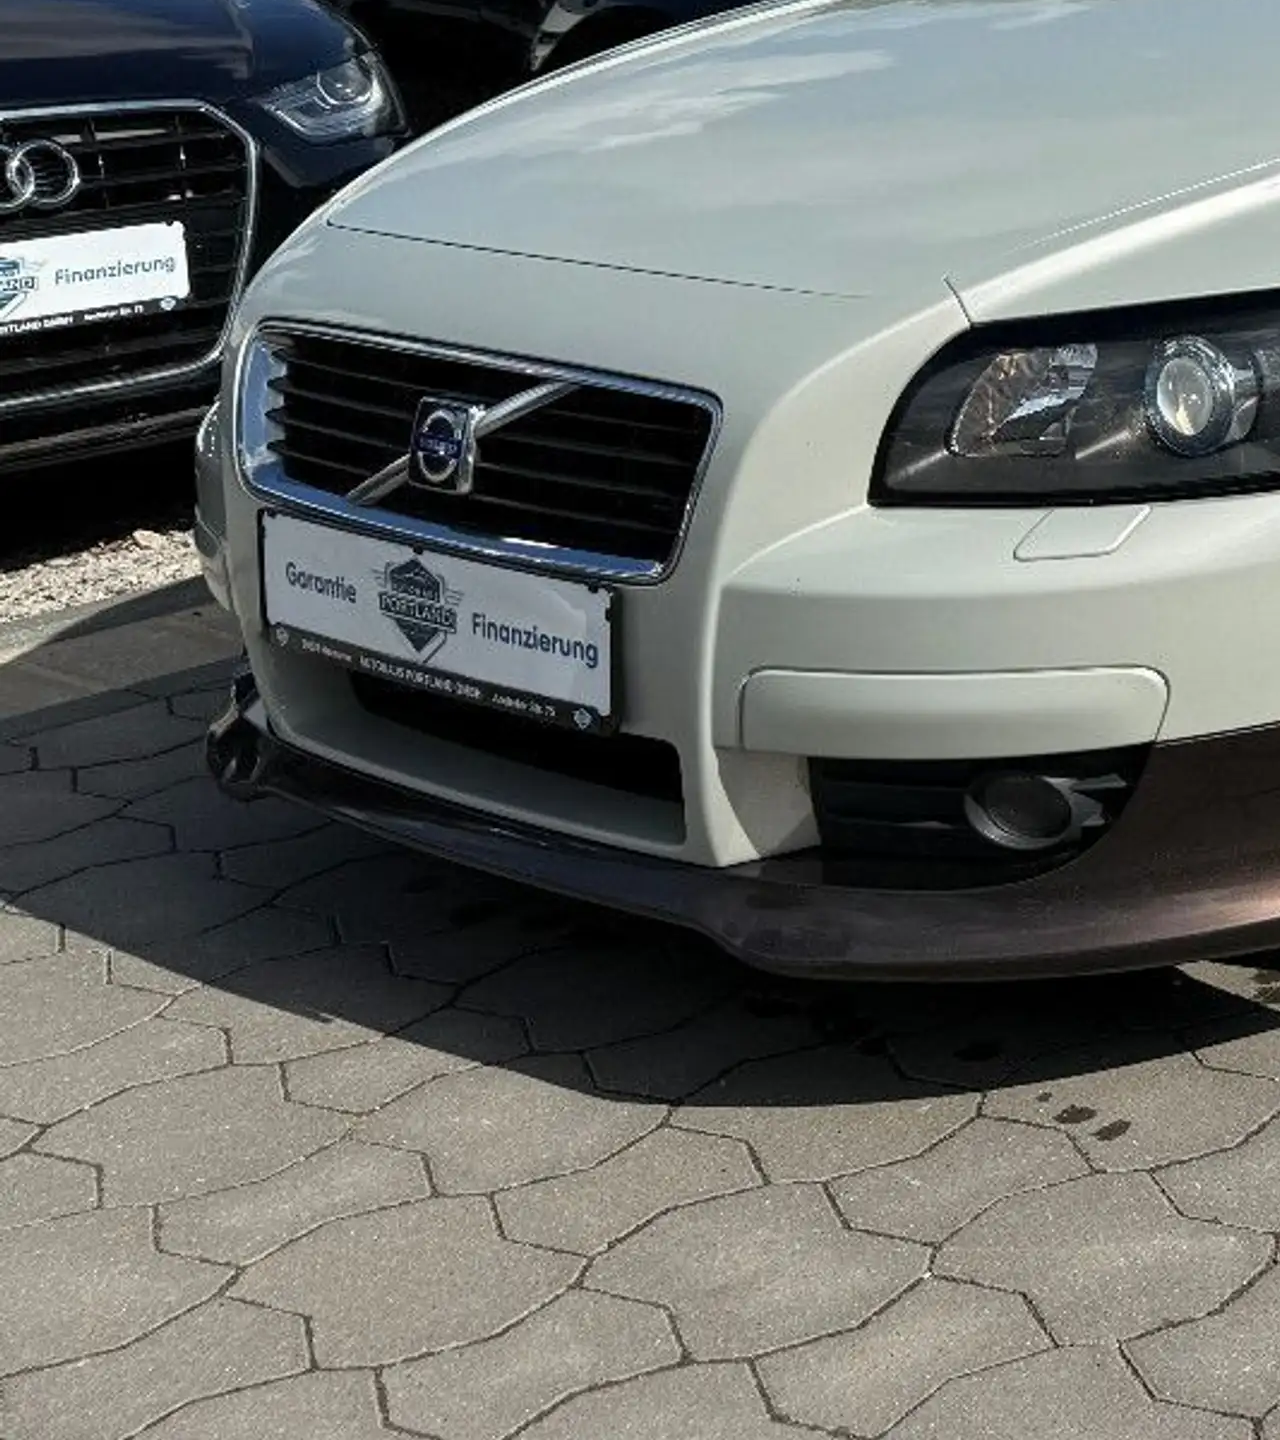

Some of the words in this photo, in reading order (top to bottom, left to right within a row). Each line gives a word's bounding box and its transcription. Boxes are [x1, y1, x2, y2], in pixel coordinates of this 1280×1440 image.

[54, 256, 176, 286] Finanzierung
[286, 561, 357, 604] Garantie
[472, 612, 599, 670] Finanzierung
